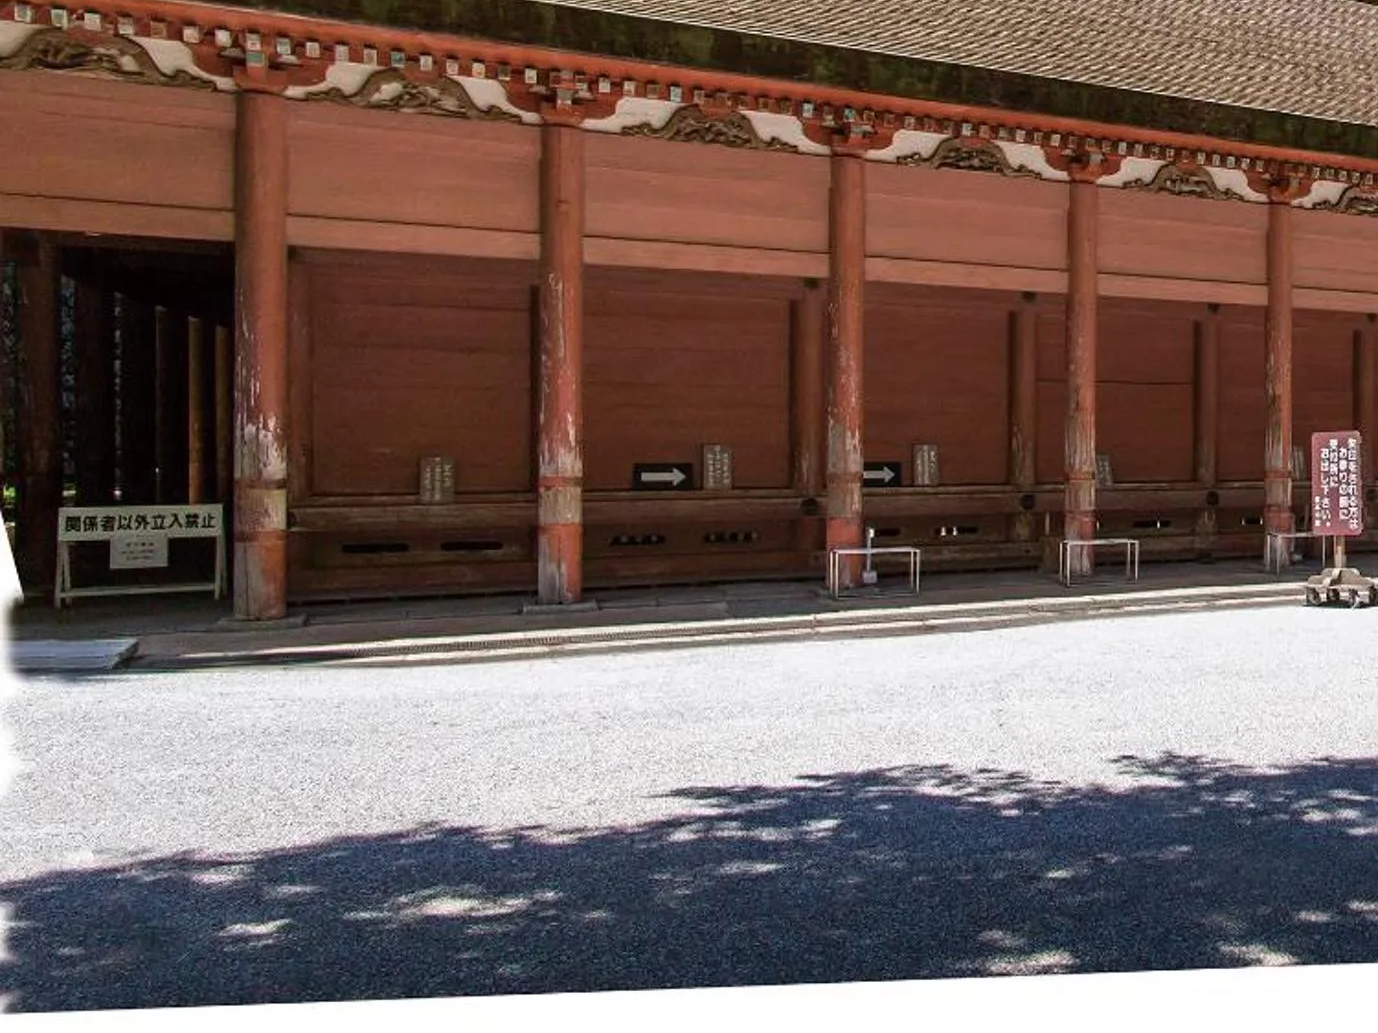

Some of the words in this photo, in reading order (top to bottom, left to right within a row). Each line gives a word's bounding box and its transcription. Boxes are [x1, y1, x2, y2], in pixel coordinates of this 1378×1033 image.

[65, 513, 216, 532] 関係者以外立入禁止
